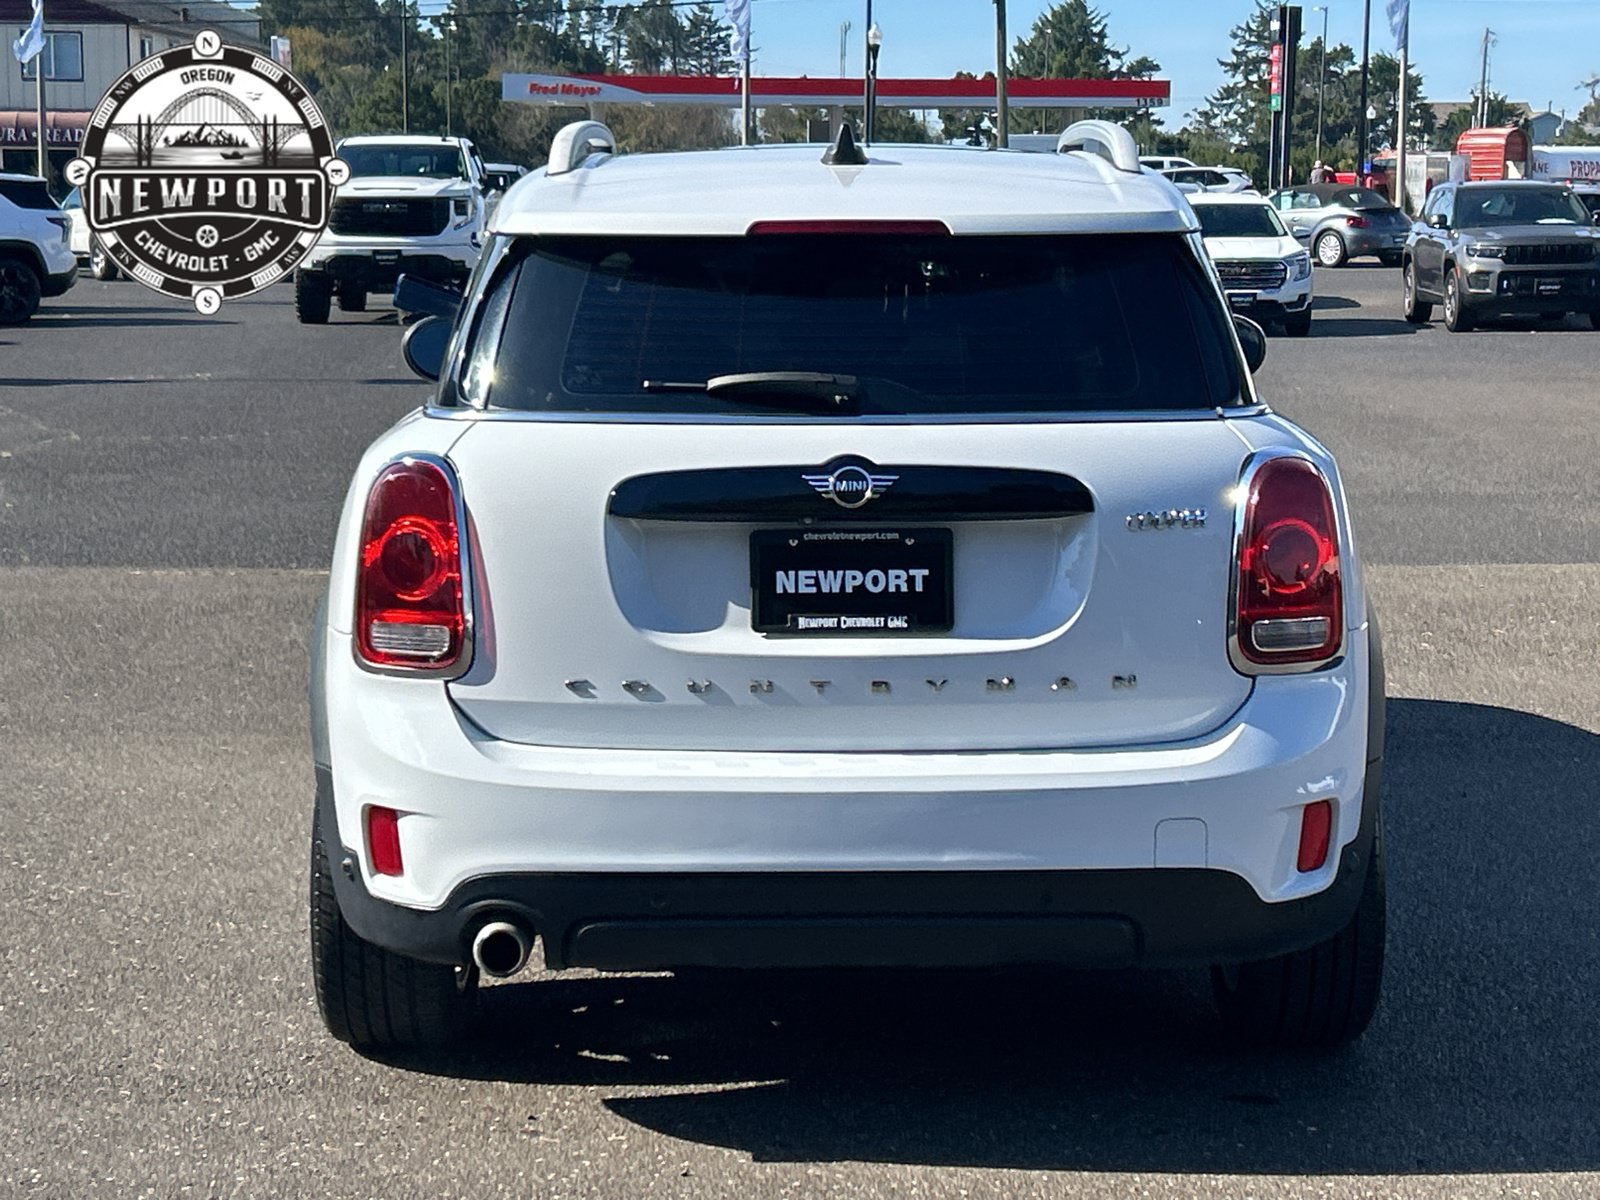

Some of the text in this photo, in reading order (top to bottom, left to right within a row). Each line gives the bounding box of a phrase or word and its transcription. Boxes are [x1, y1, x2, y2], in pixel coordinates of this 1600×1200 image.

[528, 82, 559, 95] Fred
[835, 480, 867, 492] MINI
[803, 531, 900, 541] chevroletnewport.com
[775, 569, 929, 594] NEWPORT
[887, 616, 908, 628] GMC
